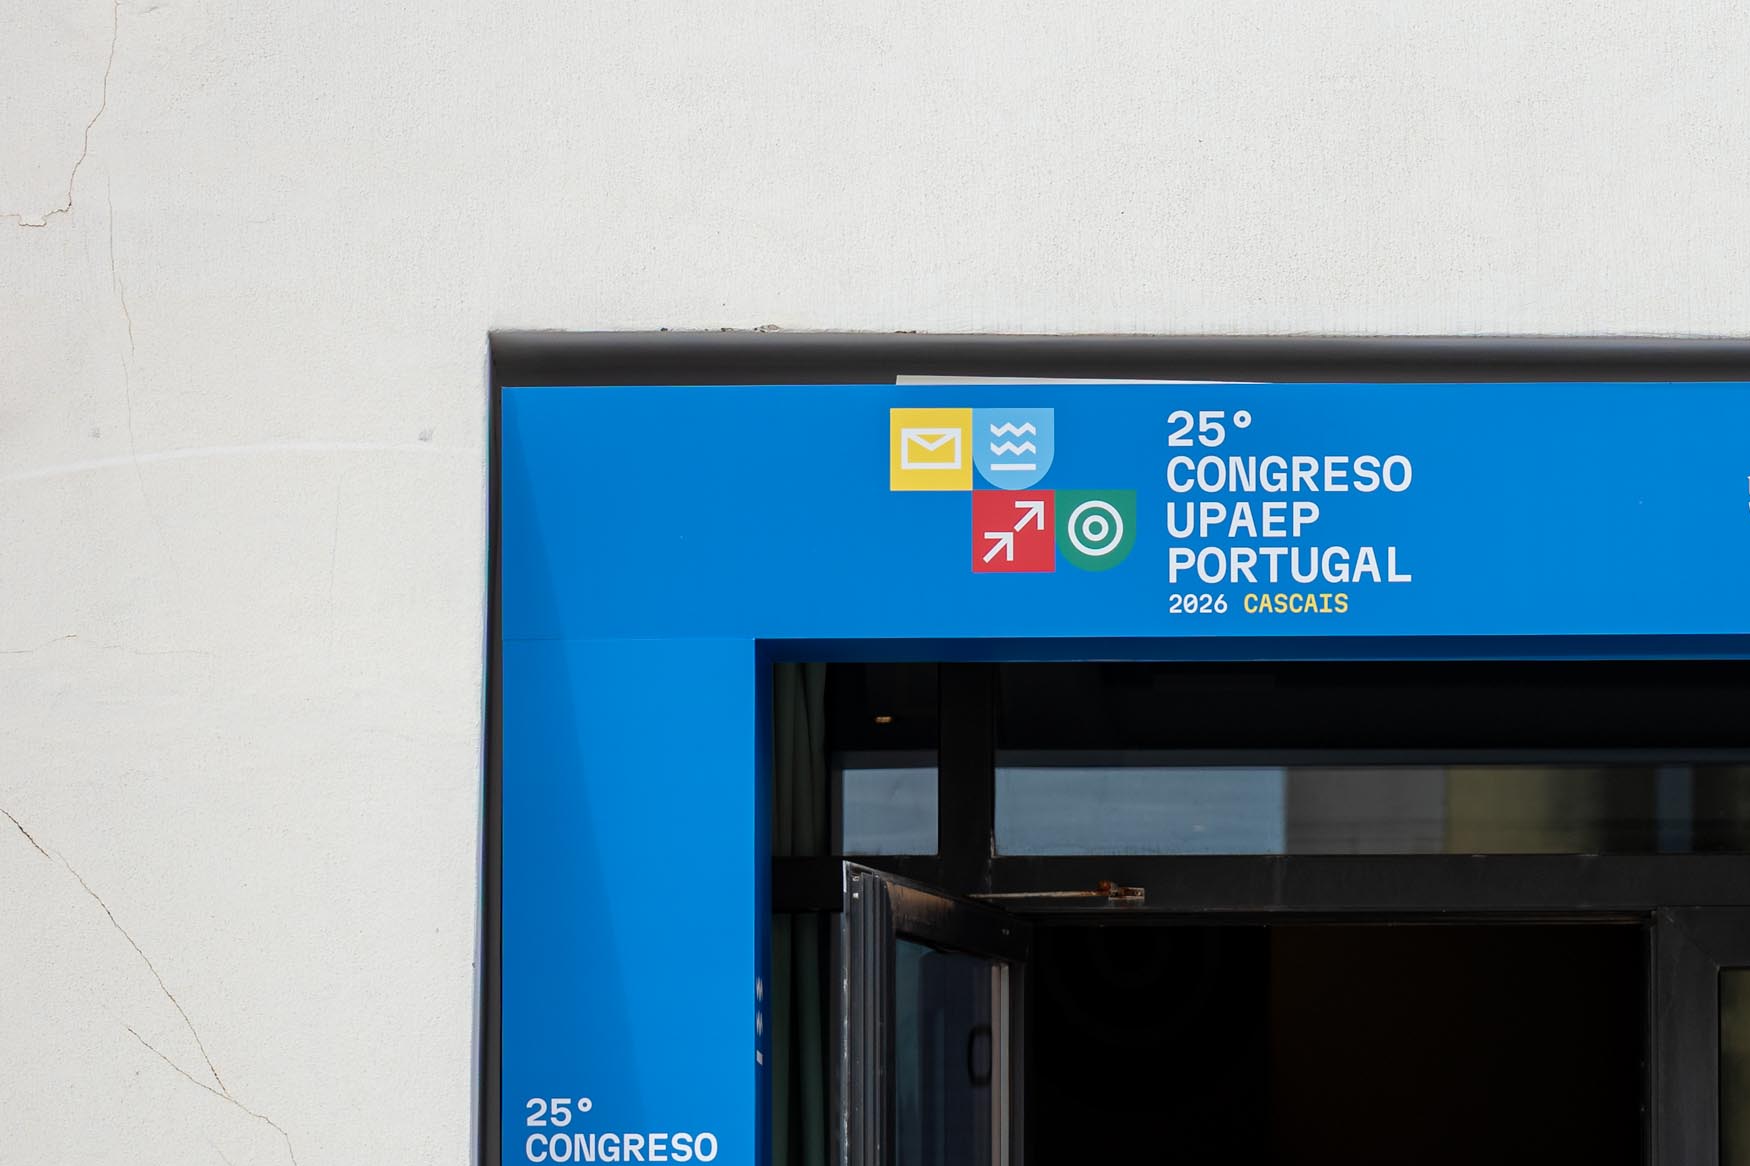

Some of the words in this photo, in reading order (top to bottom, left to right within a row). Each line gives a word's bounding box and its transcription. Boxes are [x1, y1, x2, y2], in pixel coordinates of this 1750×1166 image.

[1168, 410, 1251, 447] 25°
[1167, 455, 1412, 492] CONGRESO
[1167, 502, 1319, 538] UPAEP
[1169, 546, 1412, 583] PORTUGAL
[1169, 594, 1227, 613] 2026
[1244, 593, 1348, 613] CASCAIS
[526, 1098, 592, 1127] 25°
[526, 1133, 717, 1162] CONGRESO
